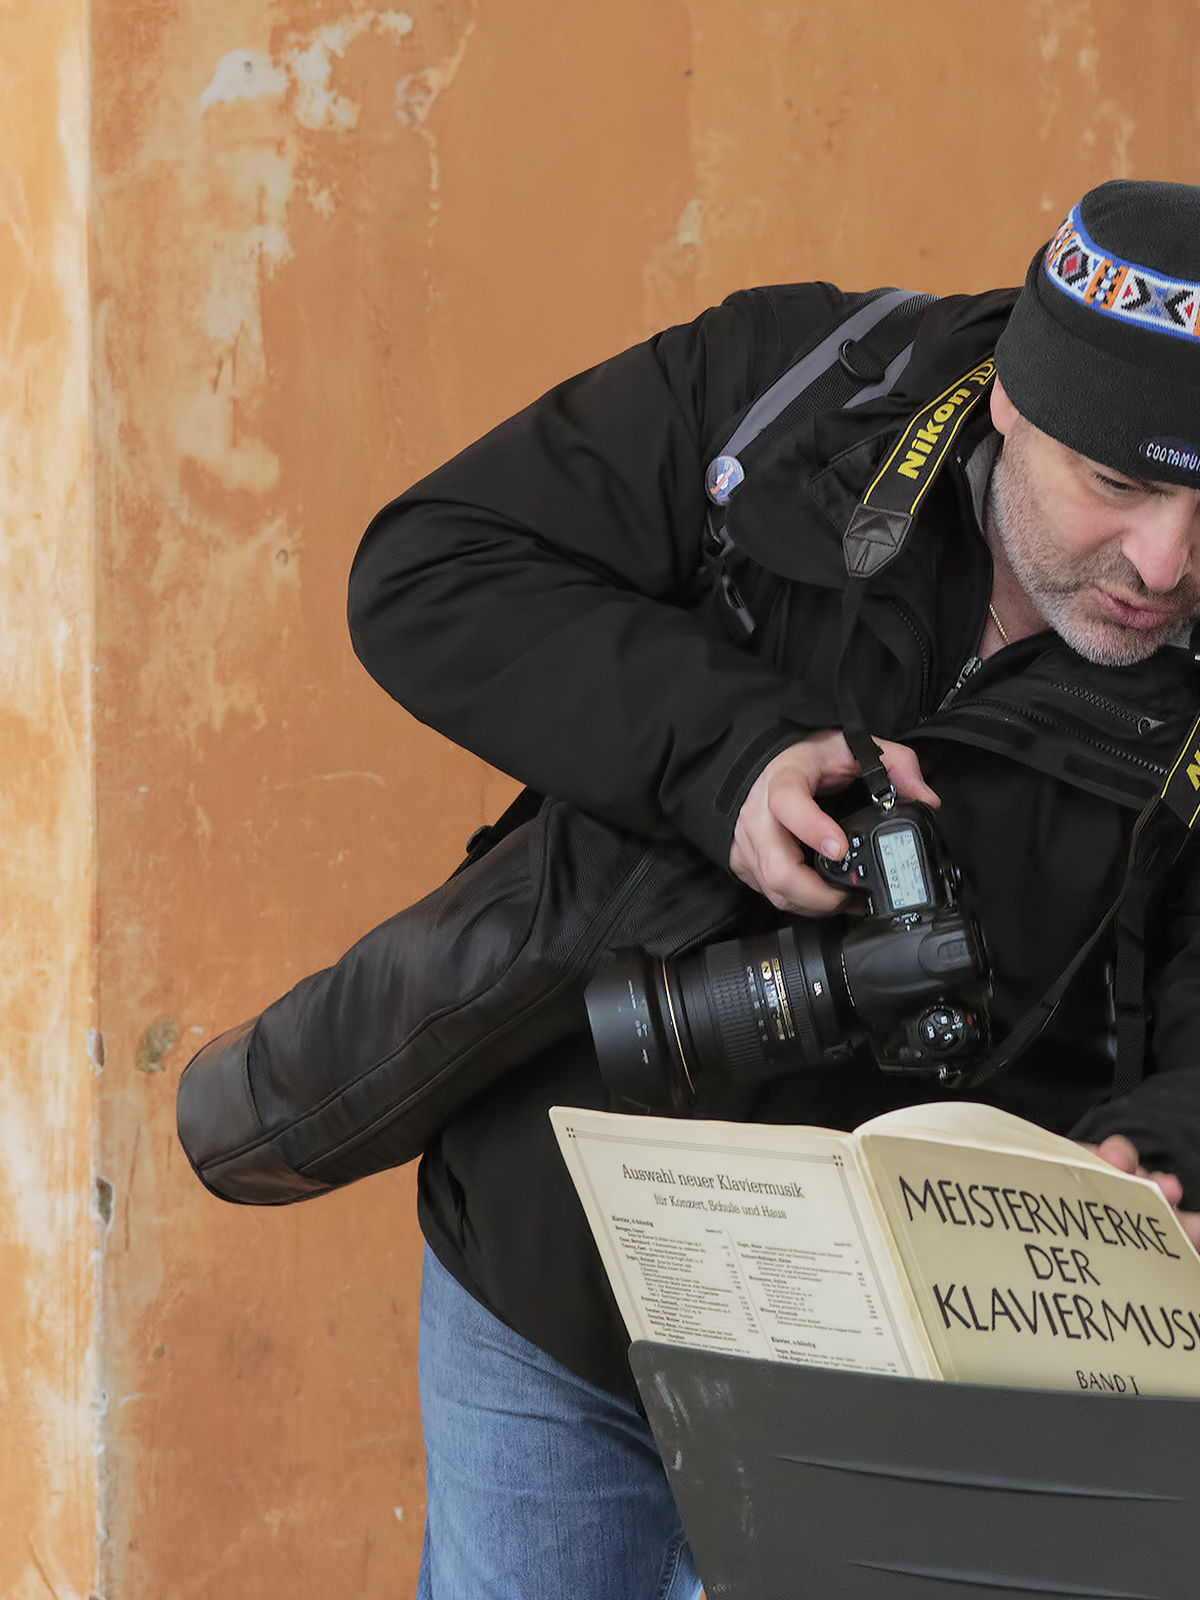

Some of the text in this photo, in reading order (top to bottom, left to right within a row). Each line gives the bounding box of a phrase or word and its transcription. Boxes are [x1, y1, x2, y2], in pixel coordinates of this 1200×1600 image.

[897, 388, 972, 480] Nikon
[622, 1163, 805, 1198] Auswahl neuer Klaviermusik
[653, 1193, 788, 1220] für Konzert, Schule und Haus
[898, 1174, 1181, 1260] MEISTERWERKE
[1023, 1243, 1102, 1287] DER
[1075, 1370, 1128, 1393] BAND
